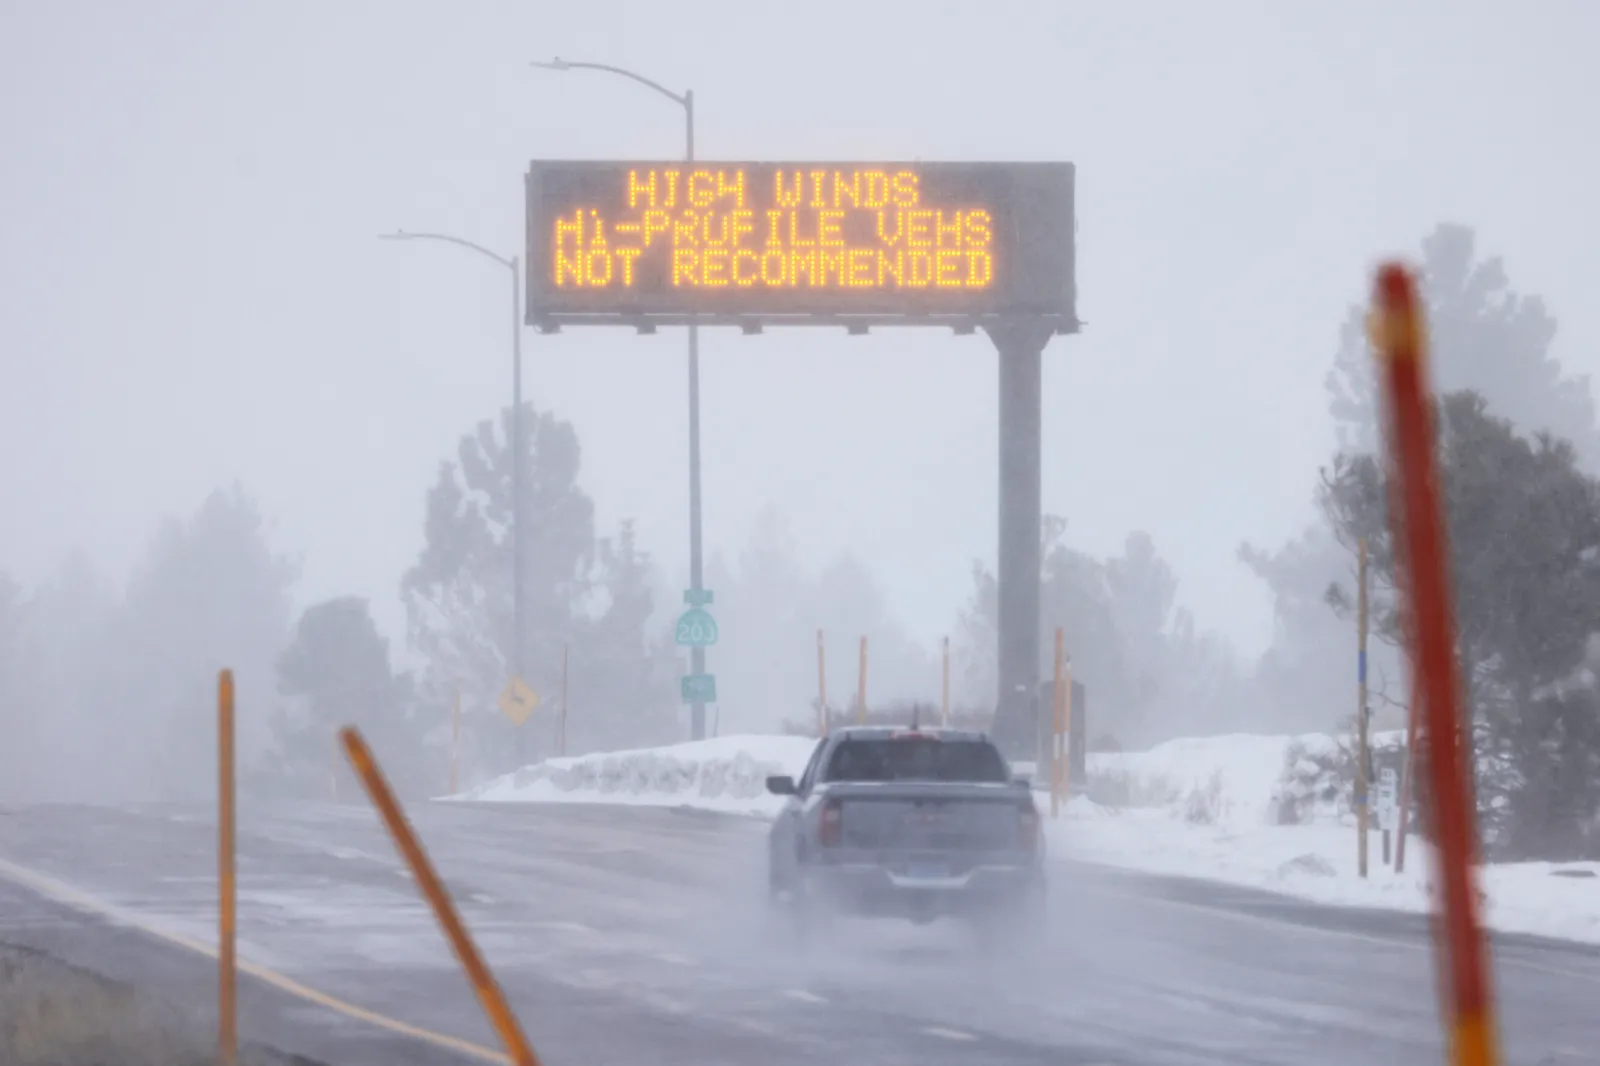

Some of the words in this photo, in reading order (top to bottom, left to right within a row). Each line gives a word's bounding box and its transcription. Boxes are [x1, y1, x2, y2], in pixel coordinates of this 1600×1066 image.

[628, 170, 745, 208] HIGH
[775, 170, 920, 208] WINDS
[877, 210, 992, 247] VEHS
[555, 248, 642, 286] NOT
[673, 248, 993, 287] RECOMMENDED
